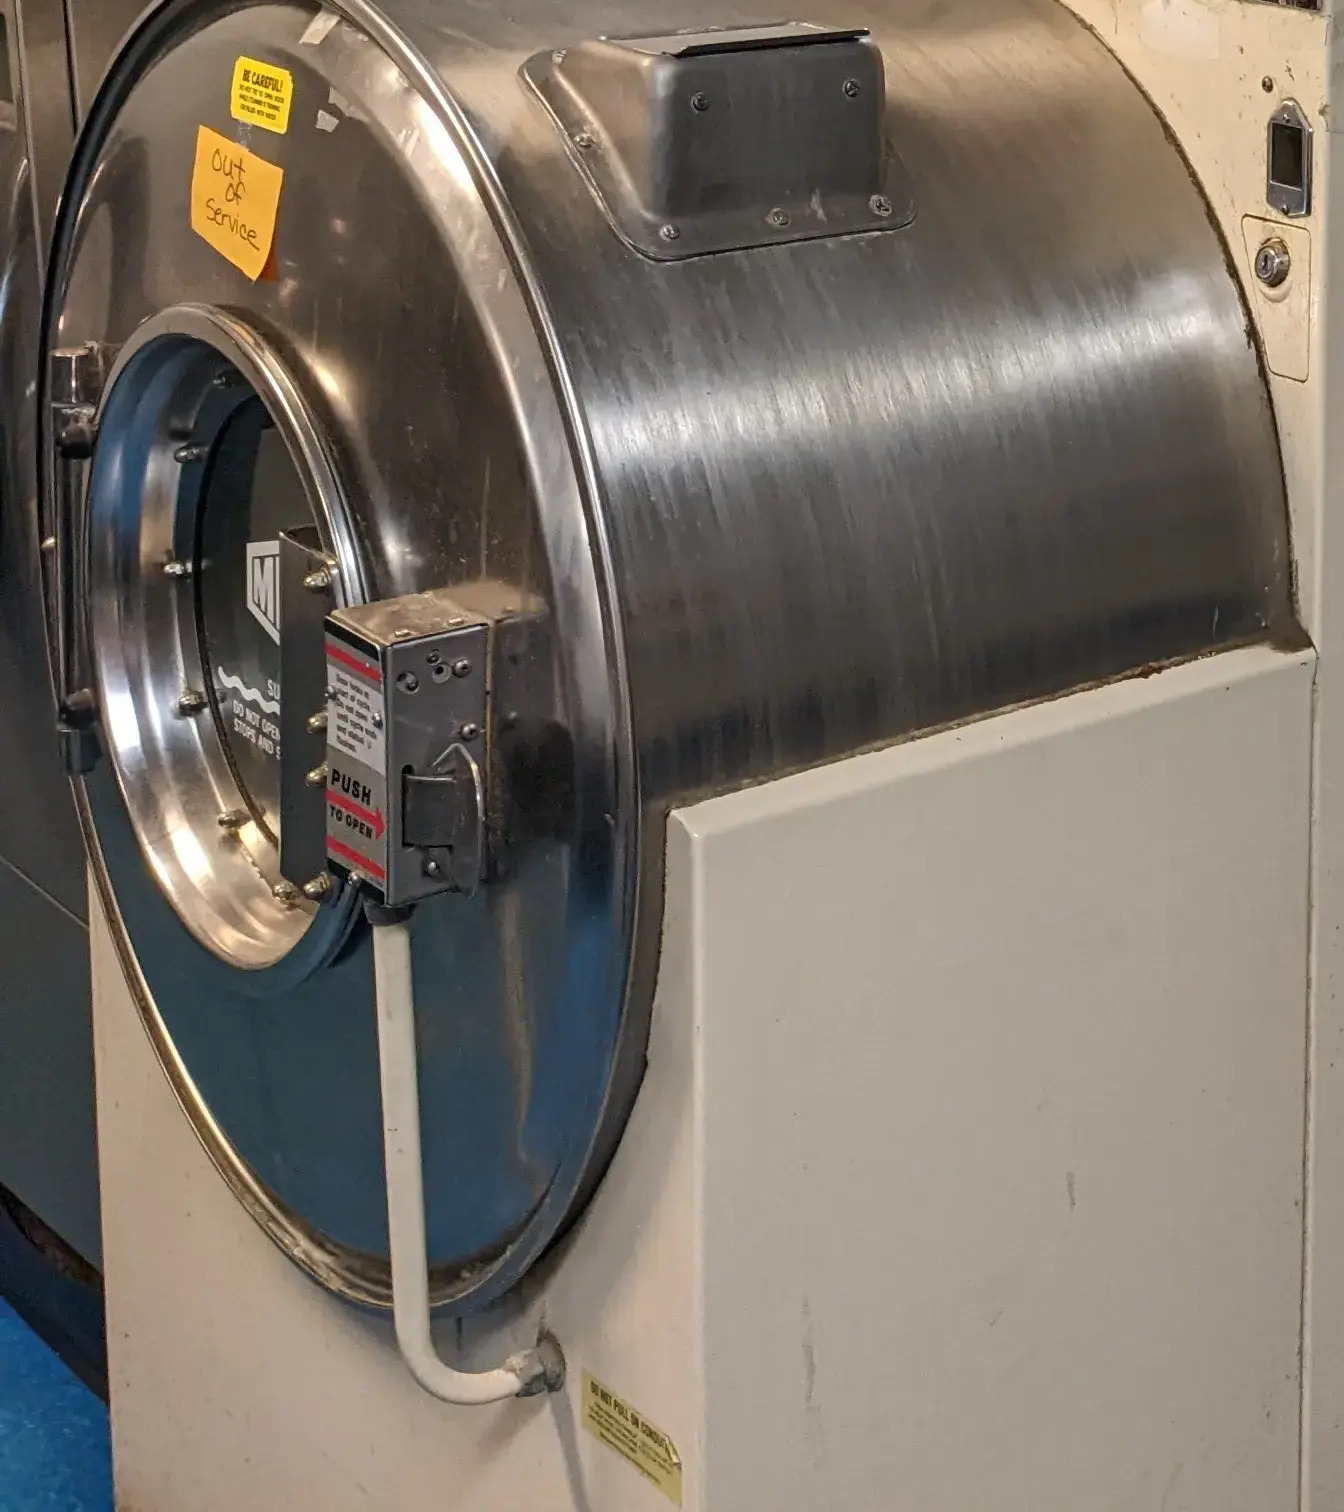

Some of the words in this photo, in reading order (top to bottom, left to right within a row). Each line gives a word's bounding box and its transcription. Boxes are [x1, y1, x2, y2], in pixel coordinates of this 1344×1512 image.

[243, 68, 251, 83] BE
[225, 181, 246, 206] of
[205, 197, 260, 252] Service
[233, 699, 244, 717] DO
[245, 707, 260, 728] NOT
[331, 768, 372, 806] PUSH
[329, 804, 343, 822] TO
[345, 813, 373, 839] OPEN
